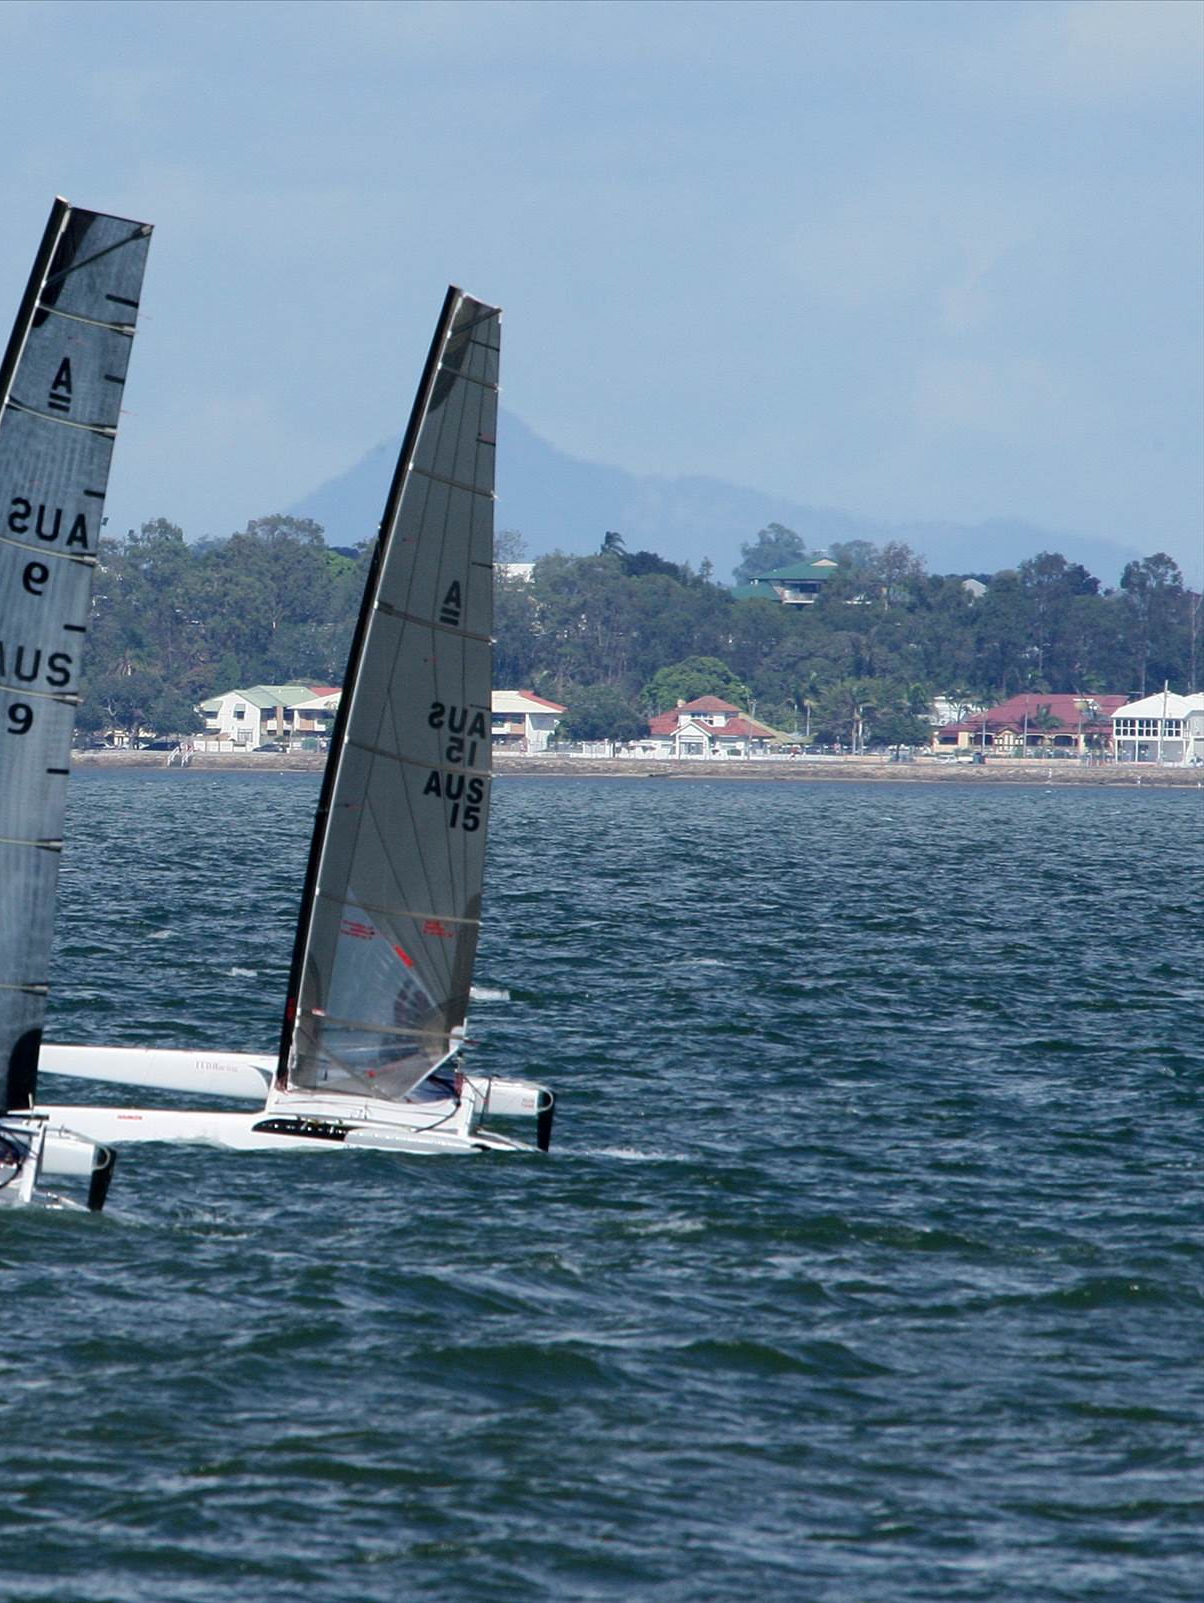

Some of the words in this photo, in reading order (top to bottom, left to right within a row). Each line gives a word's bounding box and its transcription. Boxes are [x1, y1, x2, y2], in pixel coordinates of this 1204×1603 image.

[51, 357, 73, 395] A
[442, 579, 463, 609] A
[7, 702, 34, 736] 9
[423, 769, 484, 805] AUS
[449, 801, 481, 833] 15
